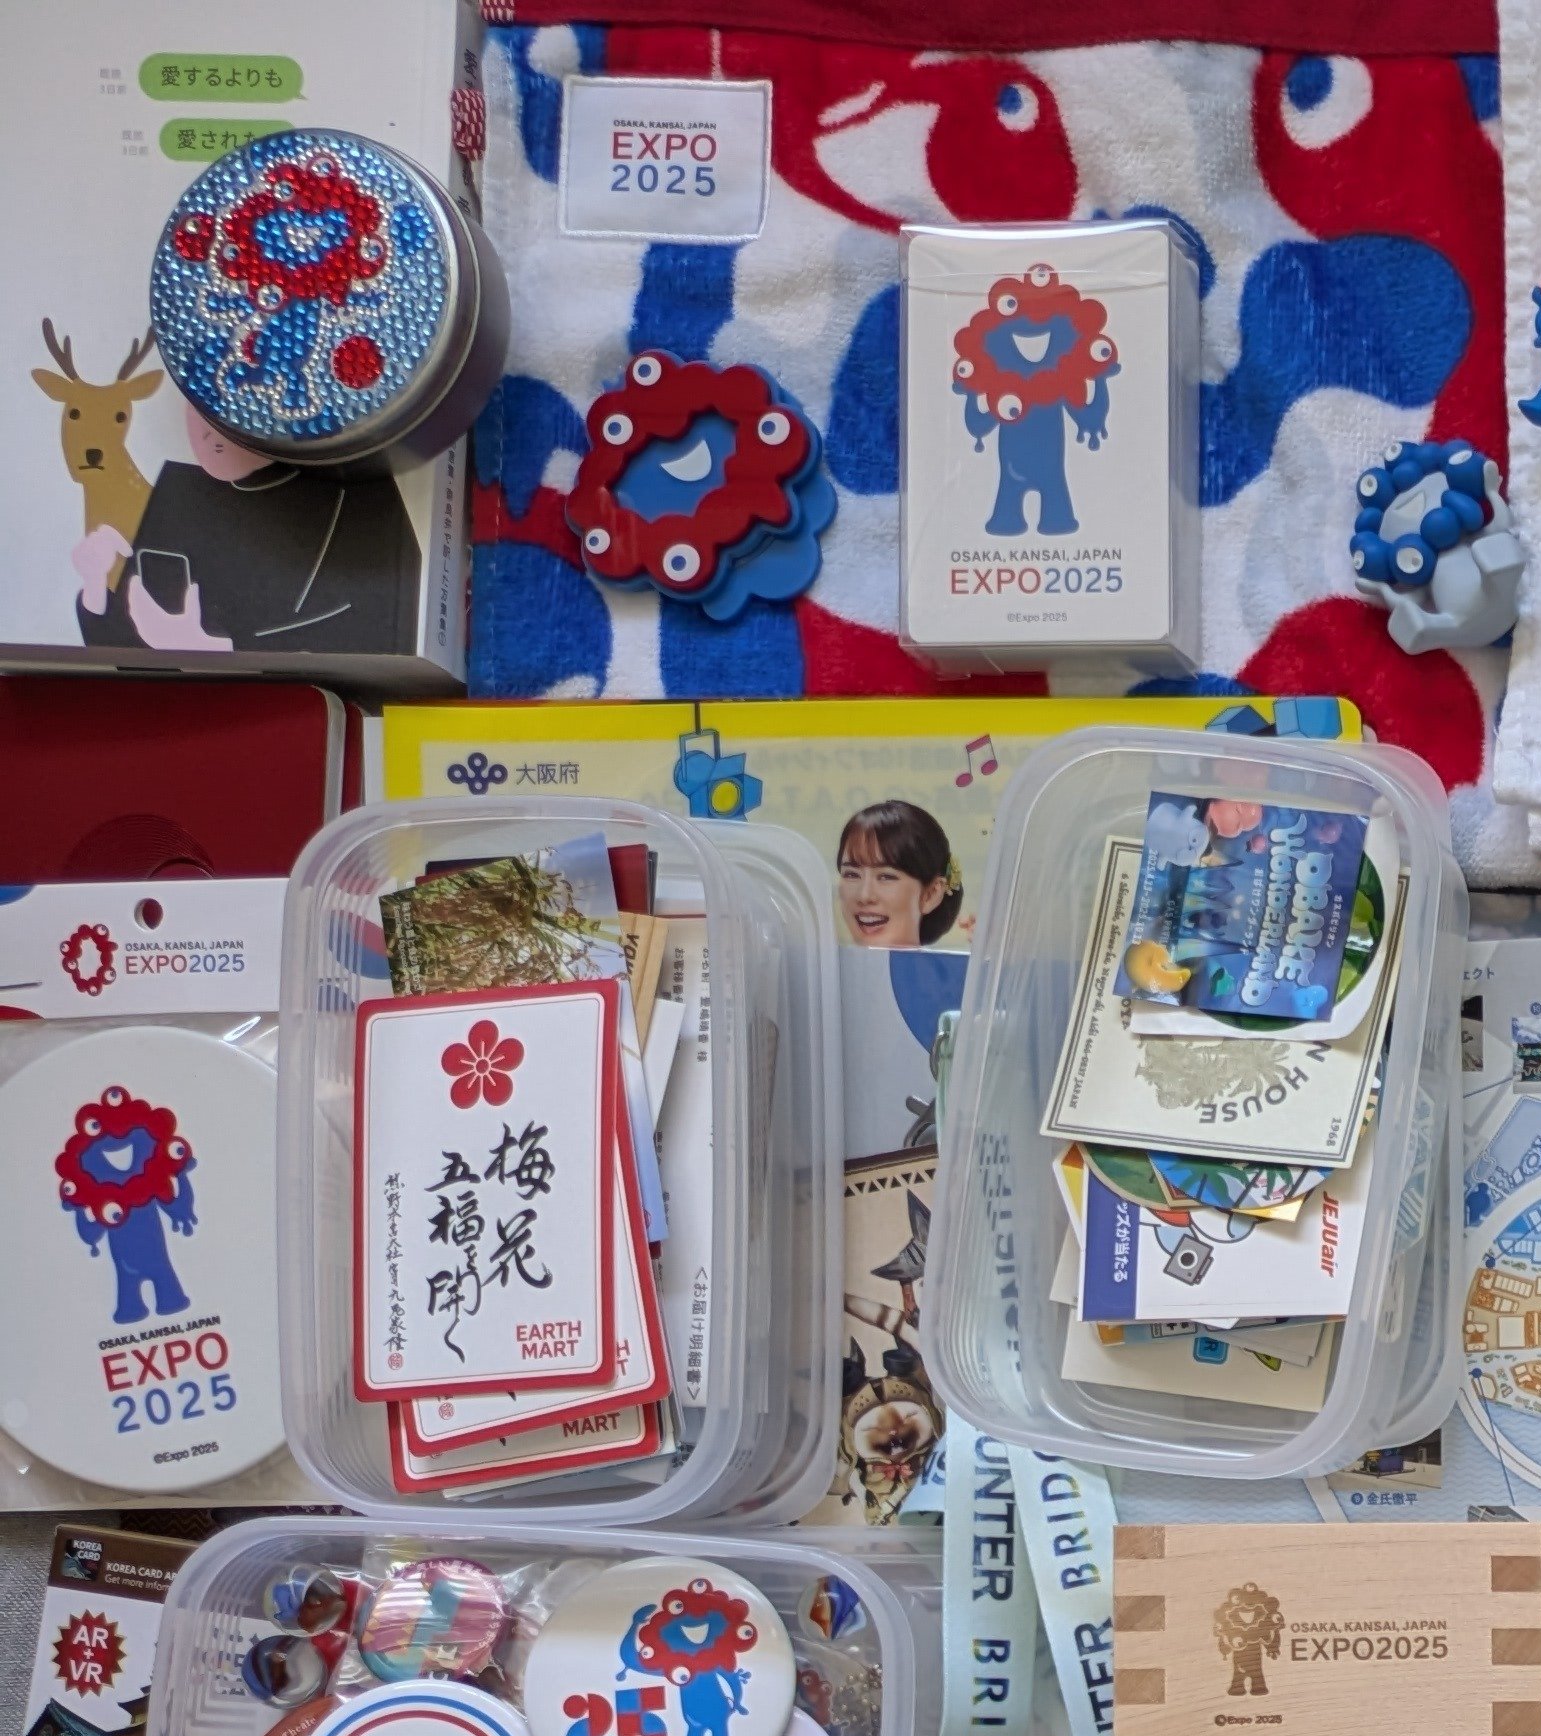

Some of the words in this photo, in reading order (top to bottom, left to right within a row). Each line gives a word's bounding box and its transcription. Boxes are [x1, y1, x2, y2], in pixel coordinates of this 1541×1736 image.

[160, 65, 284, 88] 愛するよりも
[611, 131, 718, 161] EXPO
[610, 164, 717, 197] 2025
[950, 549, 1006, 565] OSAKA,
[1008, 549, 1069, 565] KANSAI,
[1073, 548, 1123, 561] JAPAN
[950, 566, 1123, 595] EXPO2025
[515, 760, 580, 786] 大阪府
[125, 941, 164, 953] OSAKA,
[209, 940, 245, 952] JAPAN
[124, 953, 246, 976] EXPO2025
[484, 1120, 557, 1290] 梅花
[515, 1319, 583, 1343] EARTH
[102, 1332, 230, 1393] EXPO
[520, 1338, 580, 1361] MART
[111, 1373, 238, 1434] 2025
[561, 1412, 623, 1439] MART
[106, 1561, 135, 1576] KOREA
[137, 1565, 163, 1579] CARD
[72, 1623, 109, 1650] AR
[1401, 1618, 1448, 1632] JAPAN
[1289, 1636, 1450, 1664] EXPO2025
